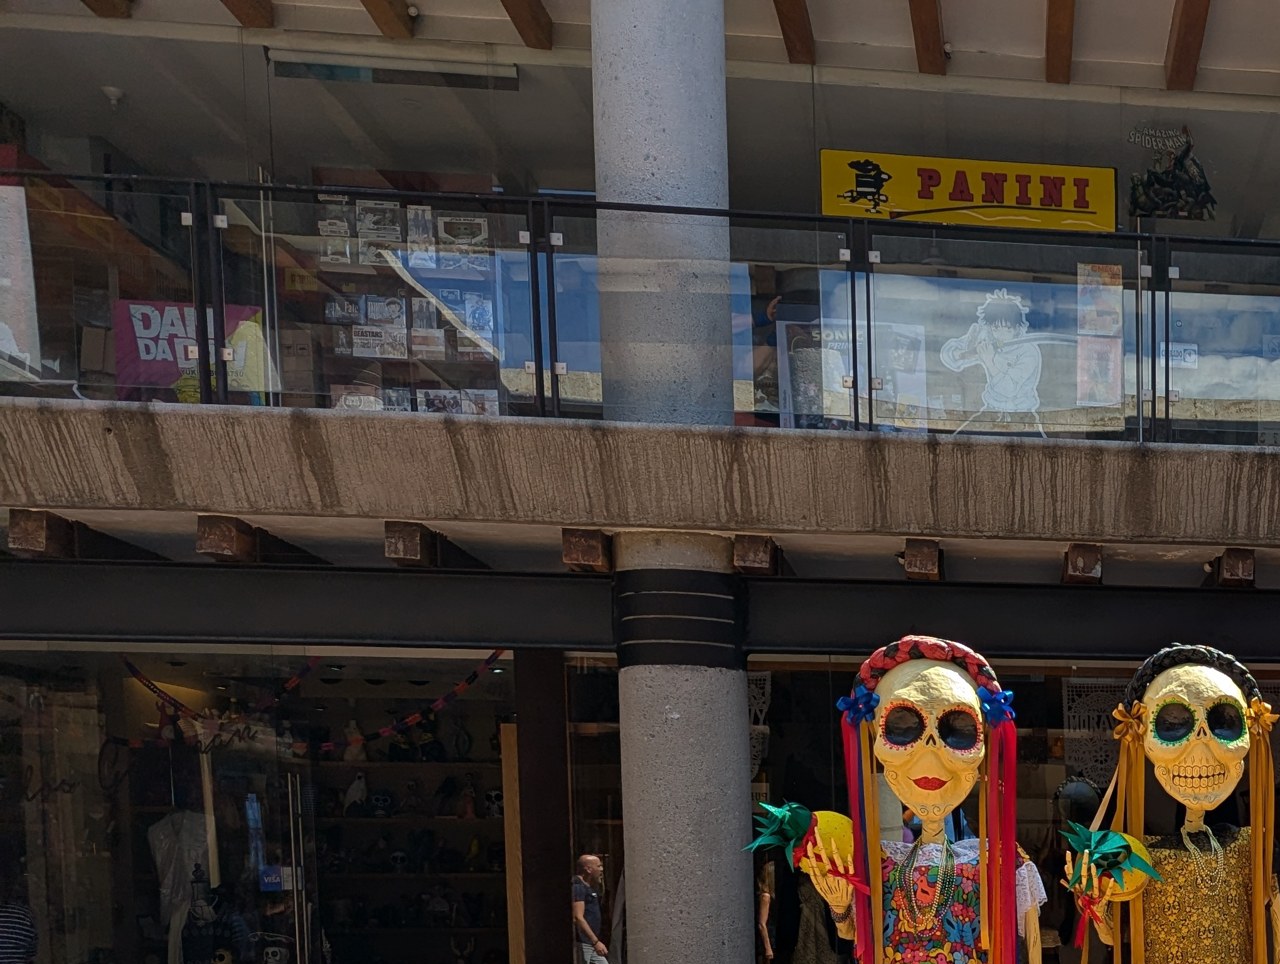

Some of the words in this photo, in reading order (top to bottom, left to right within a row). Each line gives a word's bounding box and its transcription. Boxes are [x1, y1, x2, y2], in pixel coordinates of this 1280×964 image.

[1143, 127, 1180, 138] AMAZING
[916, 167, 1090, 209] PANINI
[811, 330, 864, 342] SONC
[137, 338, 174, 362] DA
[263, 876, 281, 884] VISA
